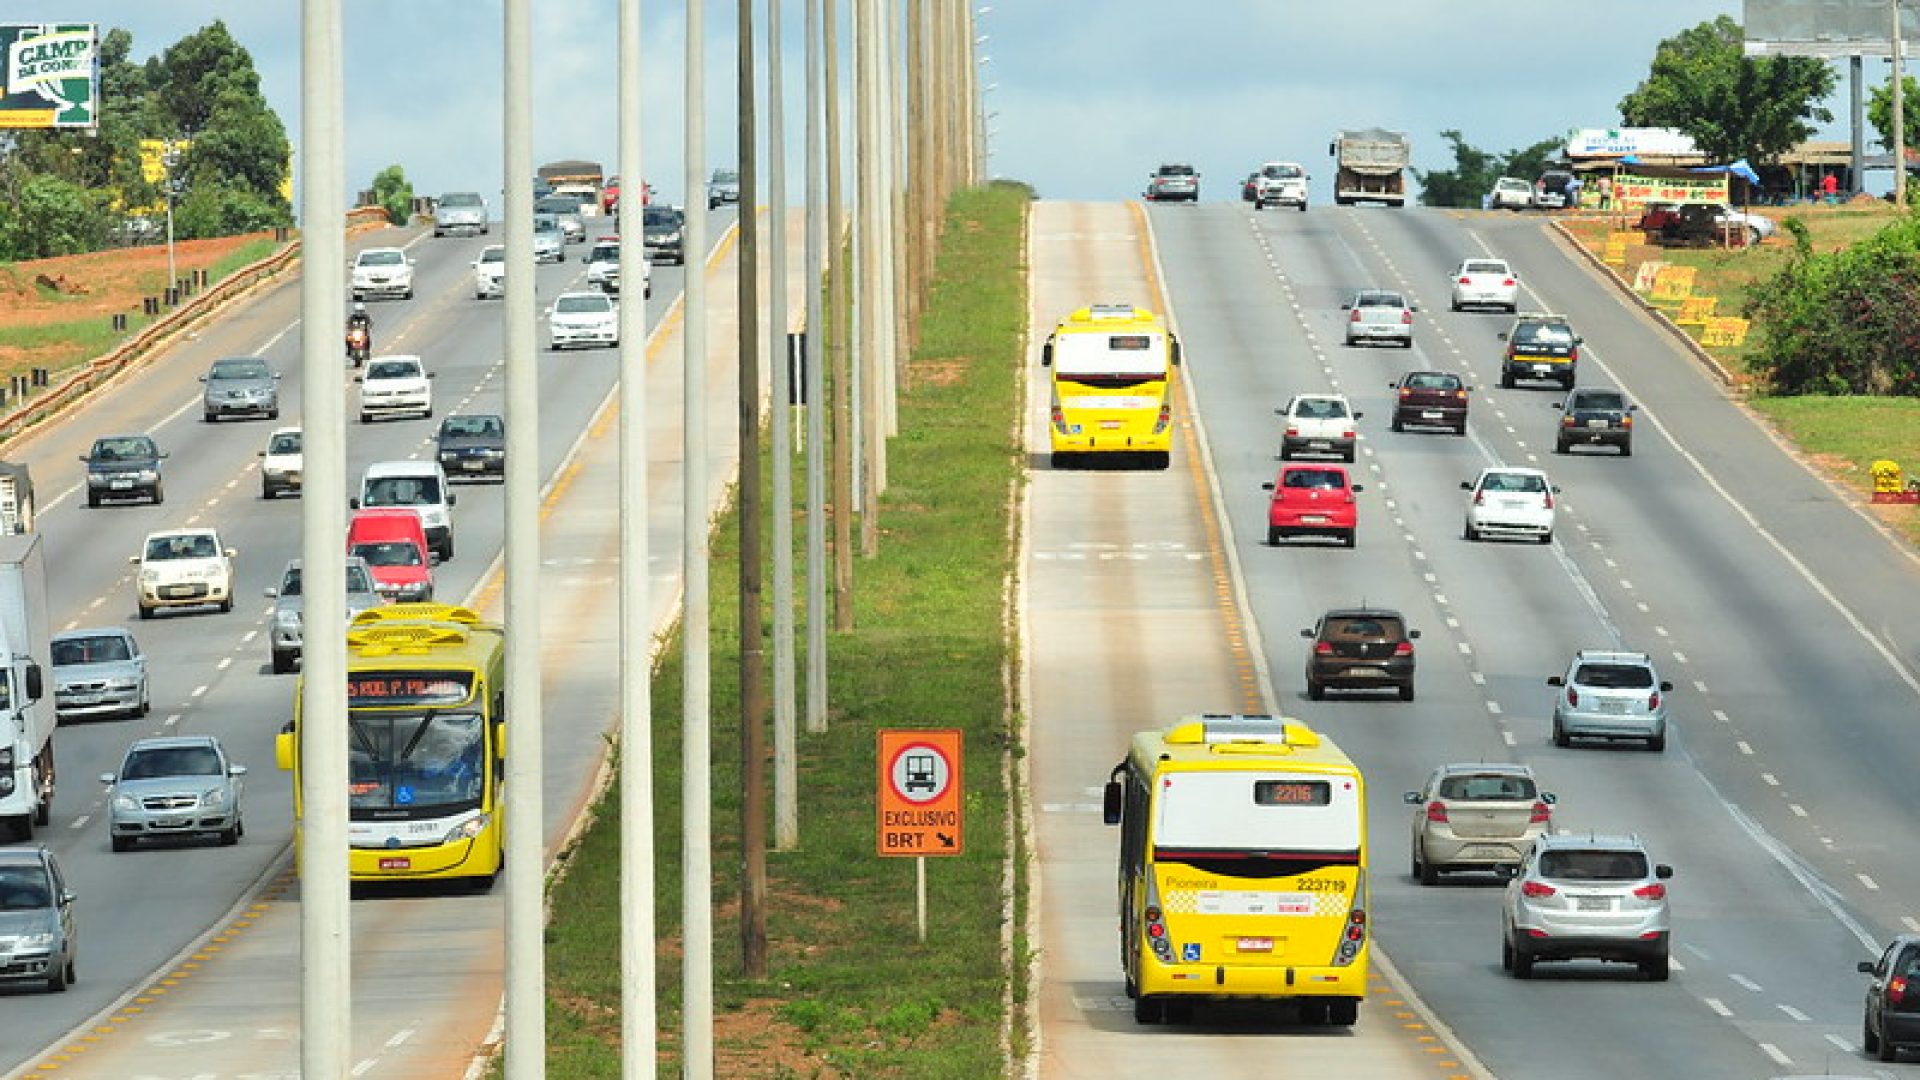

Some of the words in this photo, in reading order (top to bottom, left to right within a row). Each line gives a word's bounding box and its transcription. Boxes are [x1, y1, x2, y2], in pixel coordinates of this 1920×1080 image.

[885, 810, 956, 827] EXCLUSIVO
[887, 832, 925, 848] BRT
[1165, 875, 1218, 891] Pioneira
[1296, 877, 1347, 892] 223719
